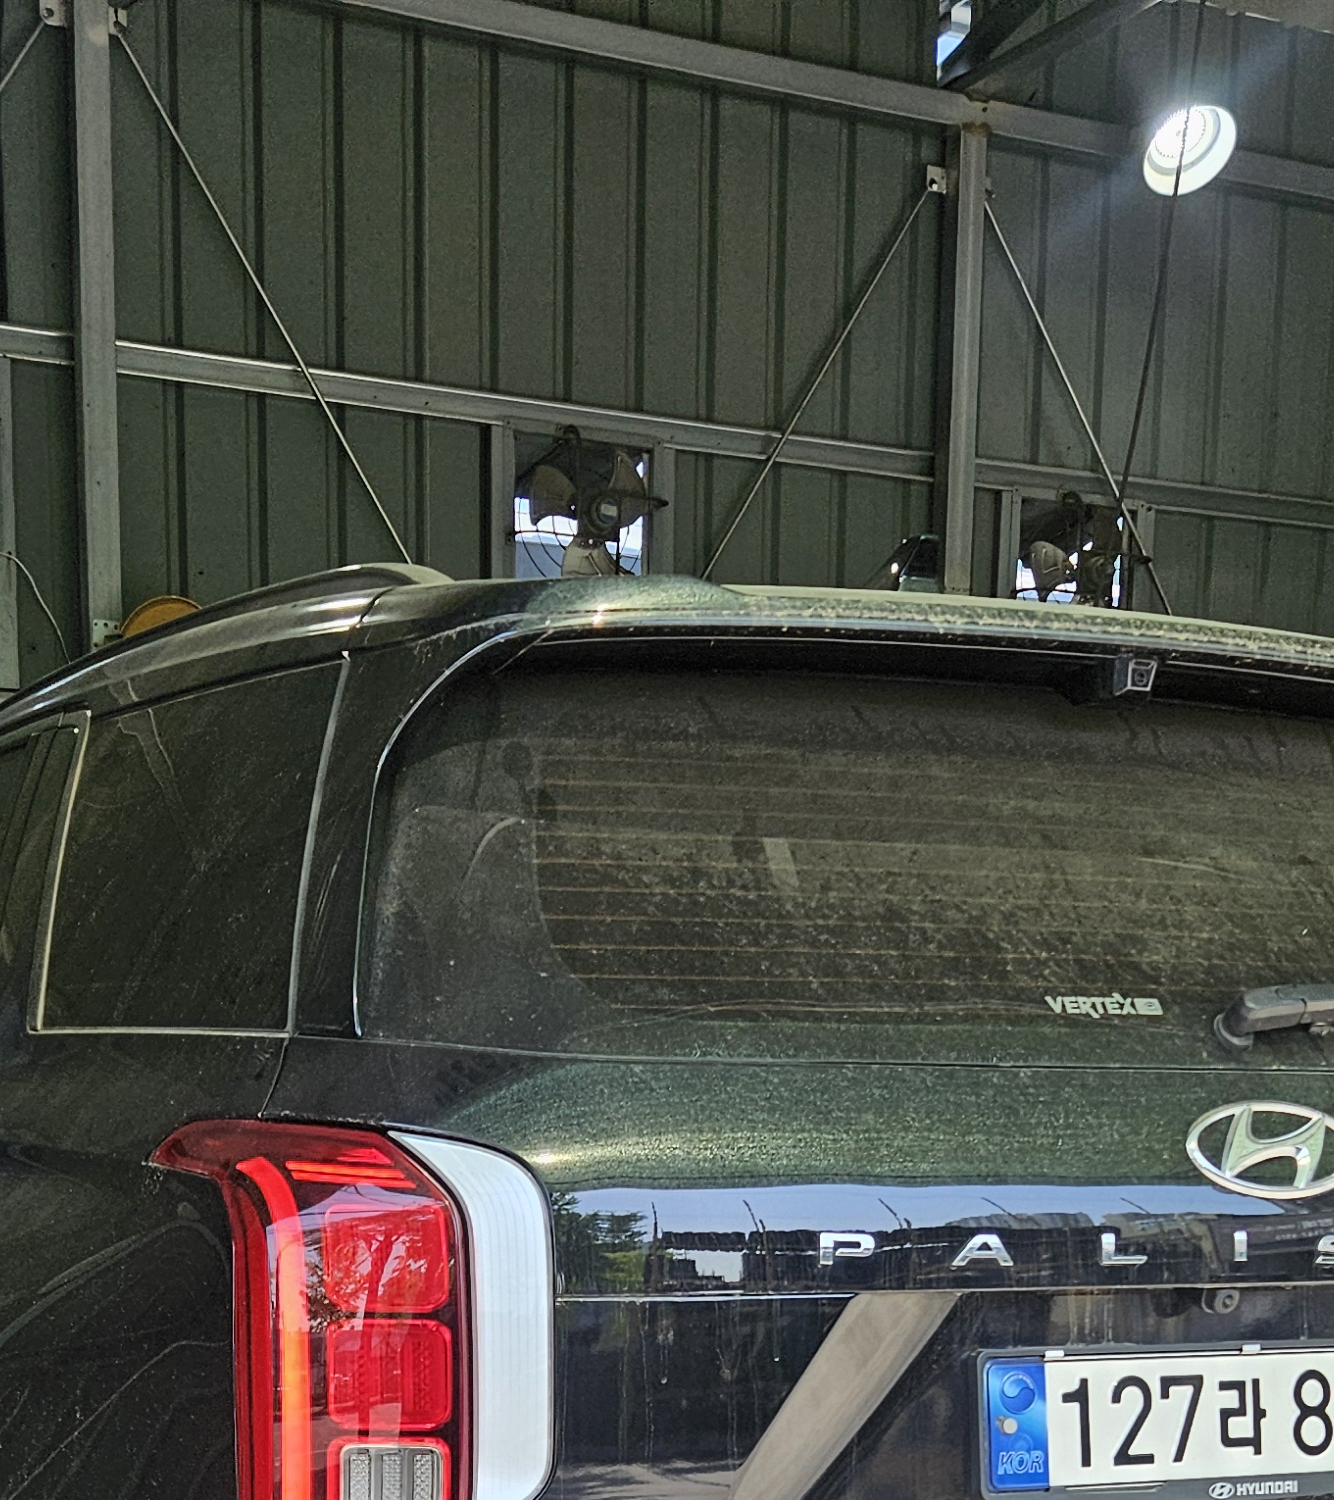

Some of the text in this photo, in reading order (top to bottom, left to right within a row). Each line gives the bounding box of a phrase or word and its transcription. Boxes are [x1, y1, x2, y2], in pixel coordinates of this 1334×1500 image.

[1044, 992, 1137, 1018] VERTEX
[1061, 1374, 1267, 1468] 127라
[997, 1450, 1045, 1475] KOR
[1236, 1480, 1298, 1496] HYUNDAI
